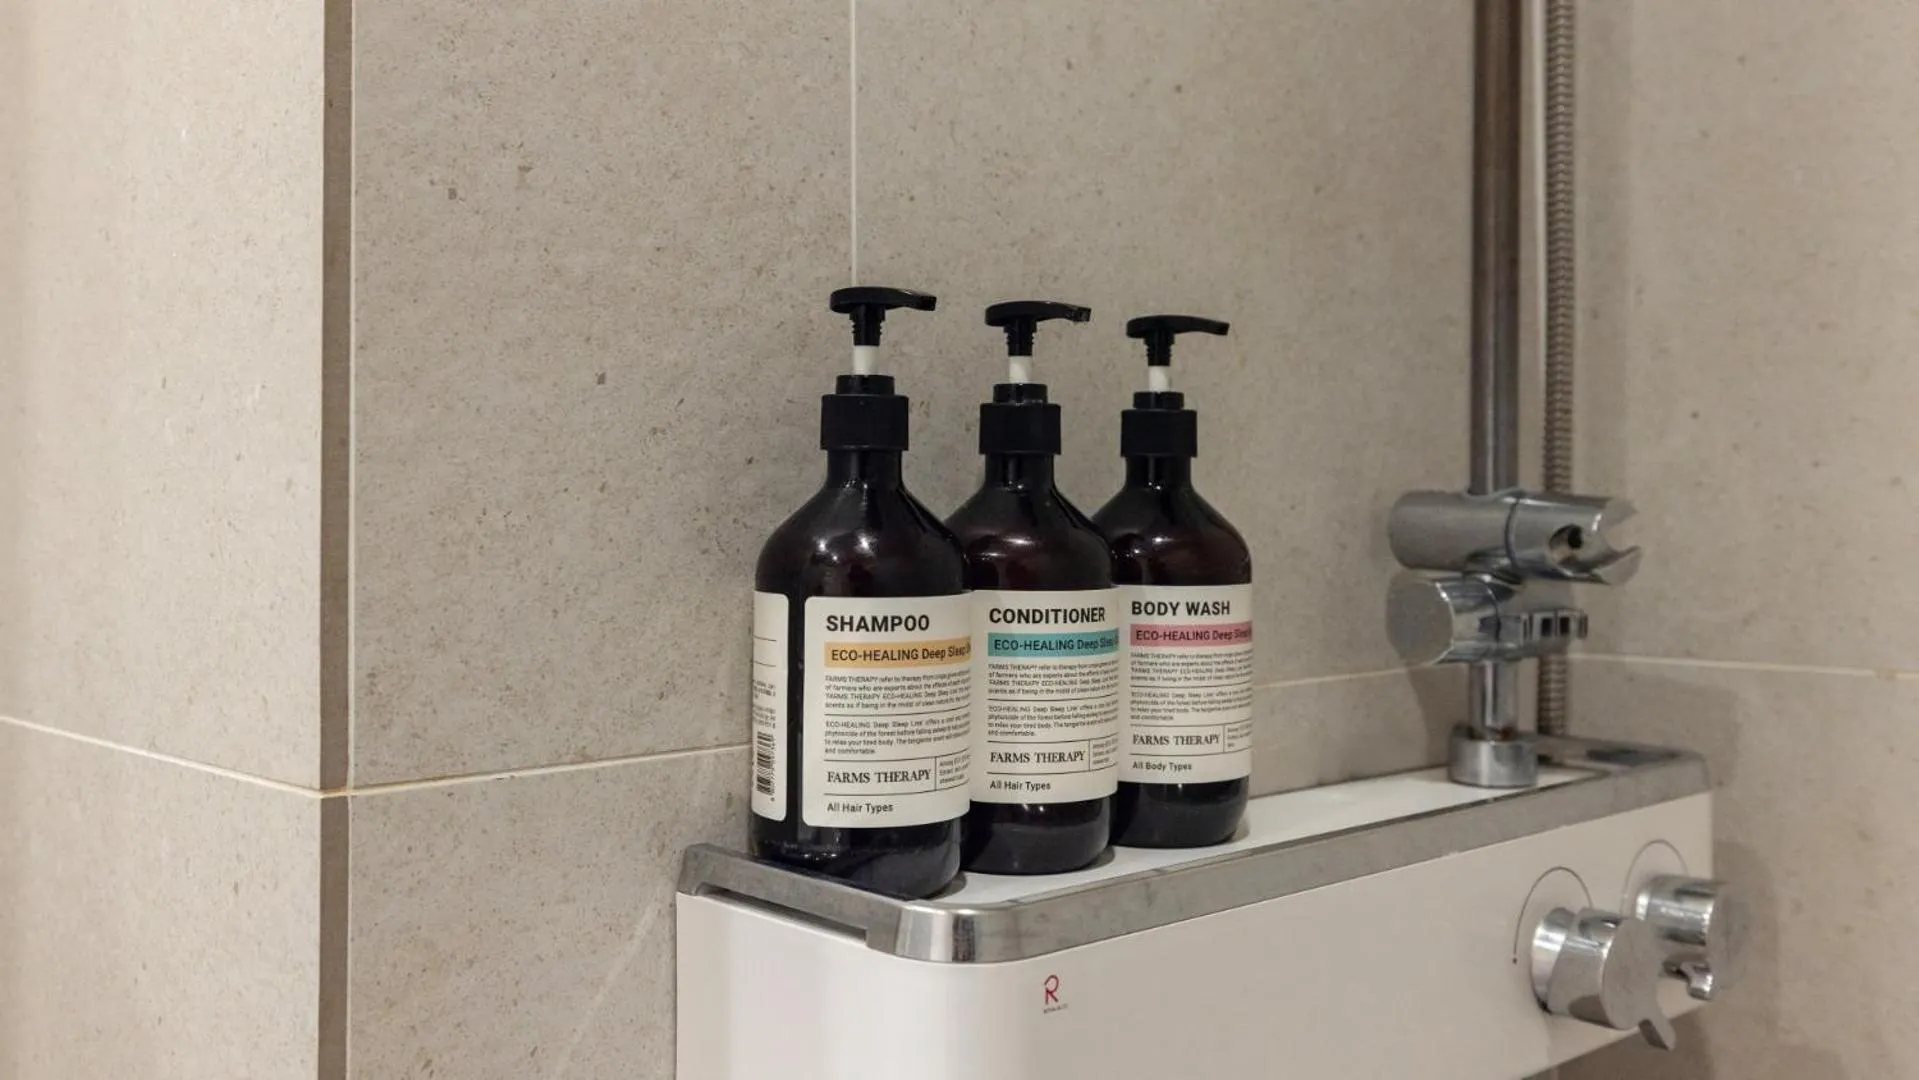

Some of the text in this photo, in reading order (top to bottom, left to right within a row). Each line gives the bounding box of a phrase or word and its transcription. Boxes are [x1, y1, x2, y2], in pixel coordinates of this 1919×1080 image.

[1131, 600, 1230, 616] BODY WASH
[989, 607, 1105, 624] CONDITIONER
[826, 614, 930, 632] SHAMPOO
[1136, 630, 1209, 641] ECO-HEALING
[994, 639, 1074, 651] ECO-HEALING
[1077, 639, 1098, 650] Deep
[832, 648, 919, 661] ECO-HEALING
[921, 647, 945, 660] Deep
[1133, 733, 1169, 745] FARMS
[1173, 733, 1220, 746] THERAPY
[990, 752, 1030, 764] FARMS
[1034, 750, 1085, 764] THERAPY
[1132, 761, 1192, 773] All Body Types
[827, 771, 870, 783] FARMS
[874, 769, 931, 783] THERAPY
[990, 781, 1051, 792] All Hair Types
[827, 803, 893, 814] All Hair Types
